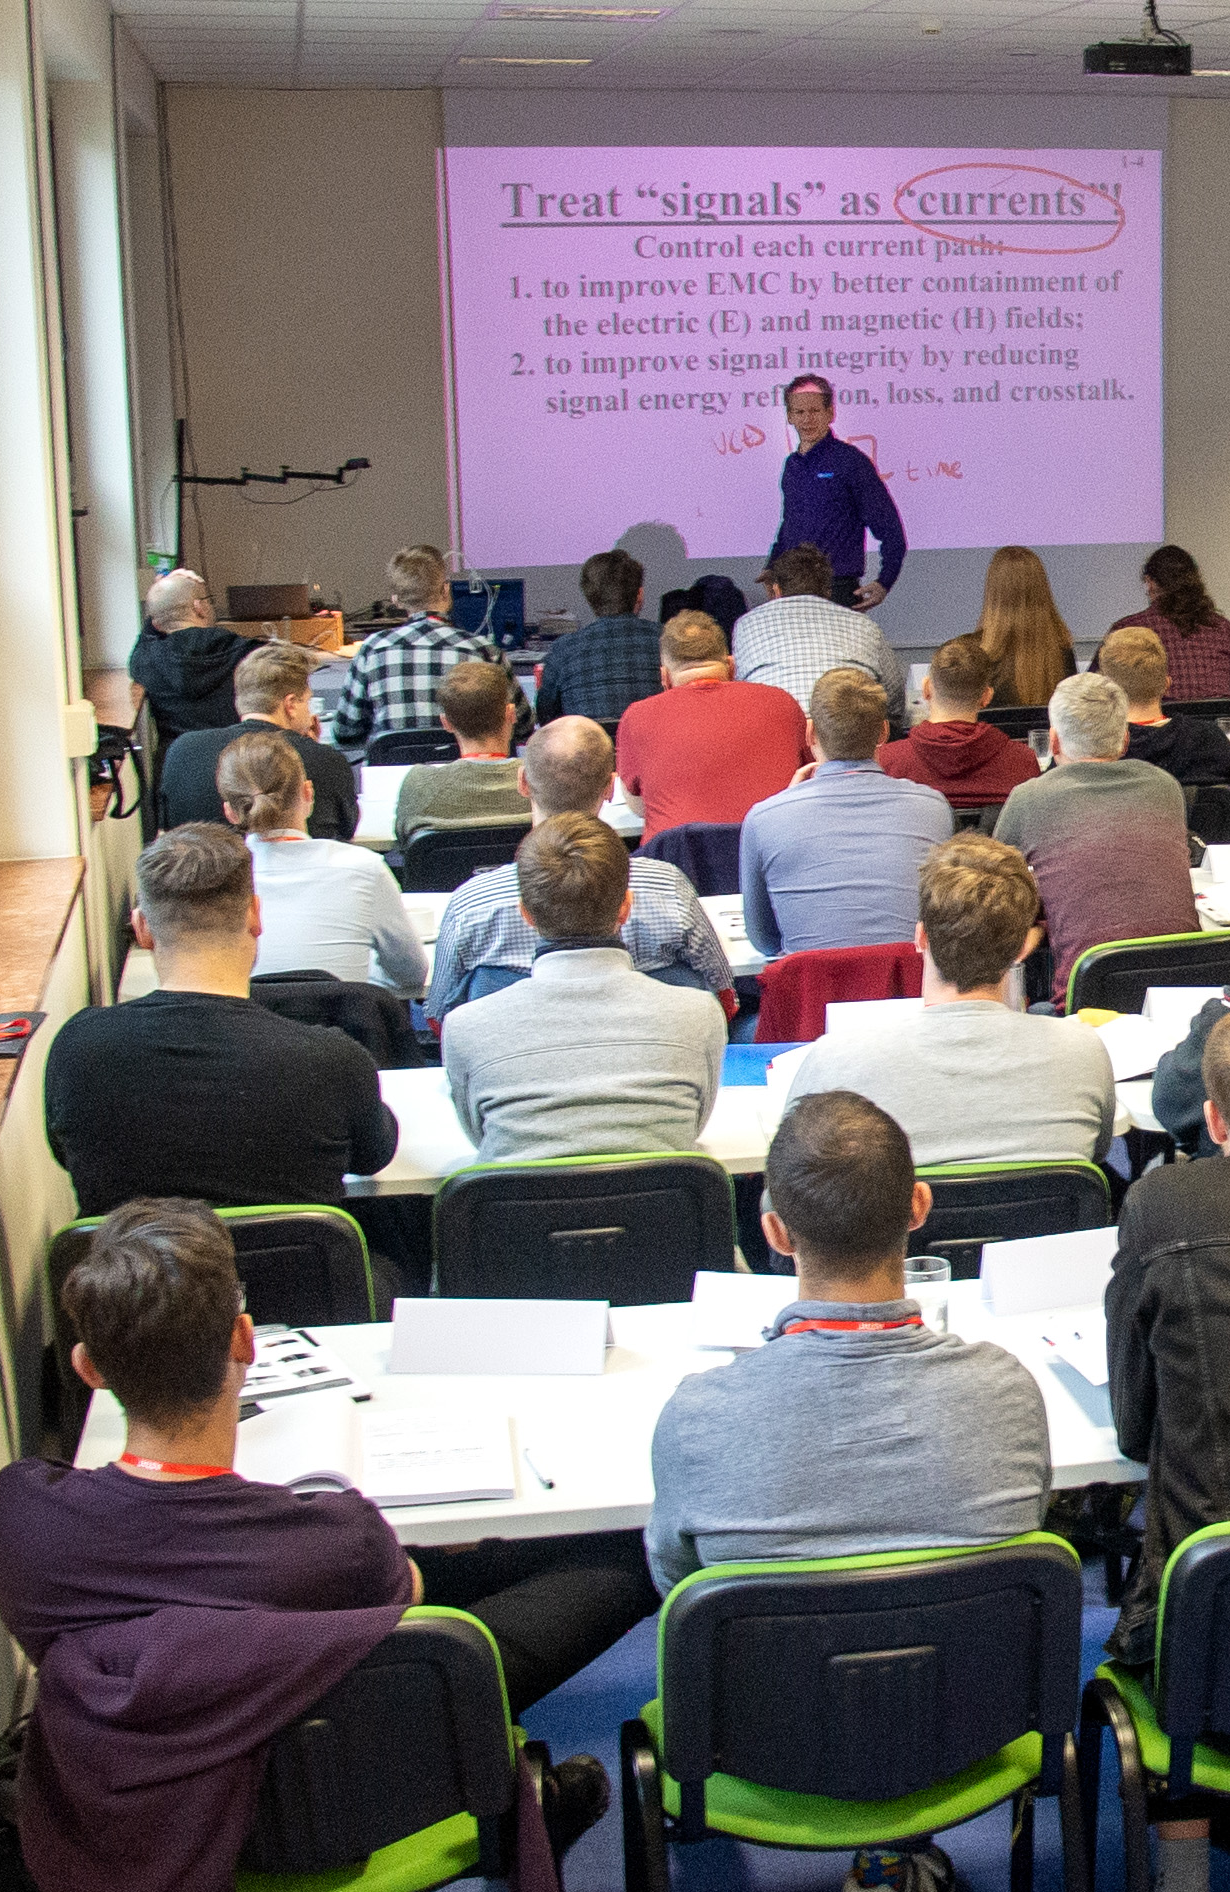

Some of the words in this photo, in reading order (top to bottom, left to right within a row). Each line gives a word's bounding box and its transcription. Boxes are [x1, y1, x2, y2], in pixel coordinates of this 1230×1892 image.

[501, 182, 622, 219] Treat
[841, 192, 880, 216] as
[635, 235, 743, 258] Control
[754, 234, 814, 257] each
[825, 238, 924, 256] current
[513, 277, 532, 298] 1.
[544, 280, 569, 298] to
[581, 275, 697, 303] improve
[709, 272, 780, 295] EMC
[792, 272, 819, 300] by
[834, 272, 912, 293] better
[923, 271, 1085, 293] containment
[1097, 270, 1122, 291] of
[545, 314, 587, 336] the
[598, 311, 699, 335] electric
[709, 310, 751, 337] (E)
[762, 309, 810, 332] and
[822, 308, 943, 336] magnetic
[952, 307, 998, 335] (H)
[1006, 306, 1084, 332] fields;
[512, 353, 534, 375] 2.
[546, 355, 572, 375] to
[583, 351, 698, 379] improve
[709, 347, 788, 375] signal
[799, 345, 908, 376] integrity
[924, 345, 950, 372] by
[965, 343, 1078, 369] reducing
[547, 389, 628, 418] signal
[638, 391, 733, 415] energy
[887, 381, 944, 407] loss,
[954, 381, 1000, 402] and
[1011, 379, 1133, 401] crosstalk.
